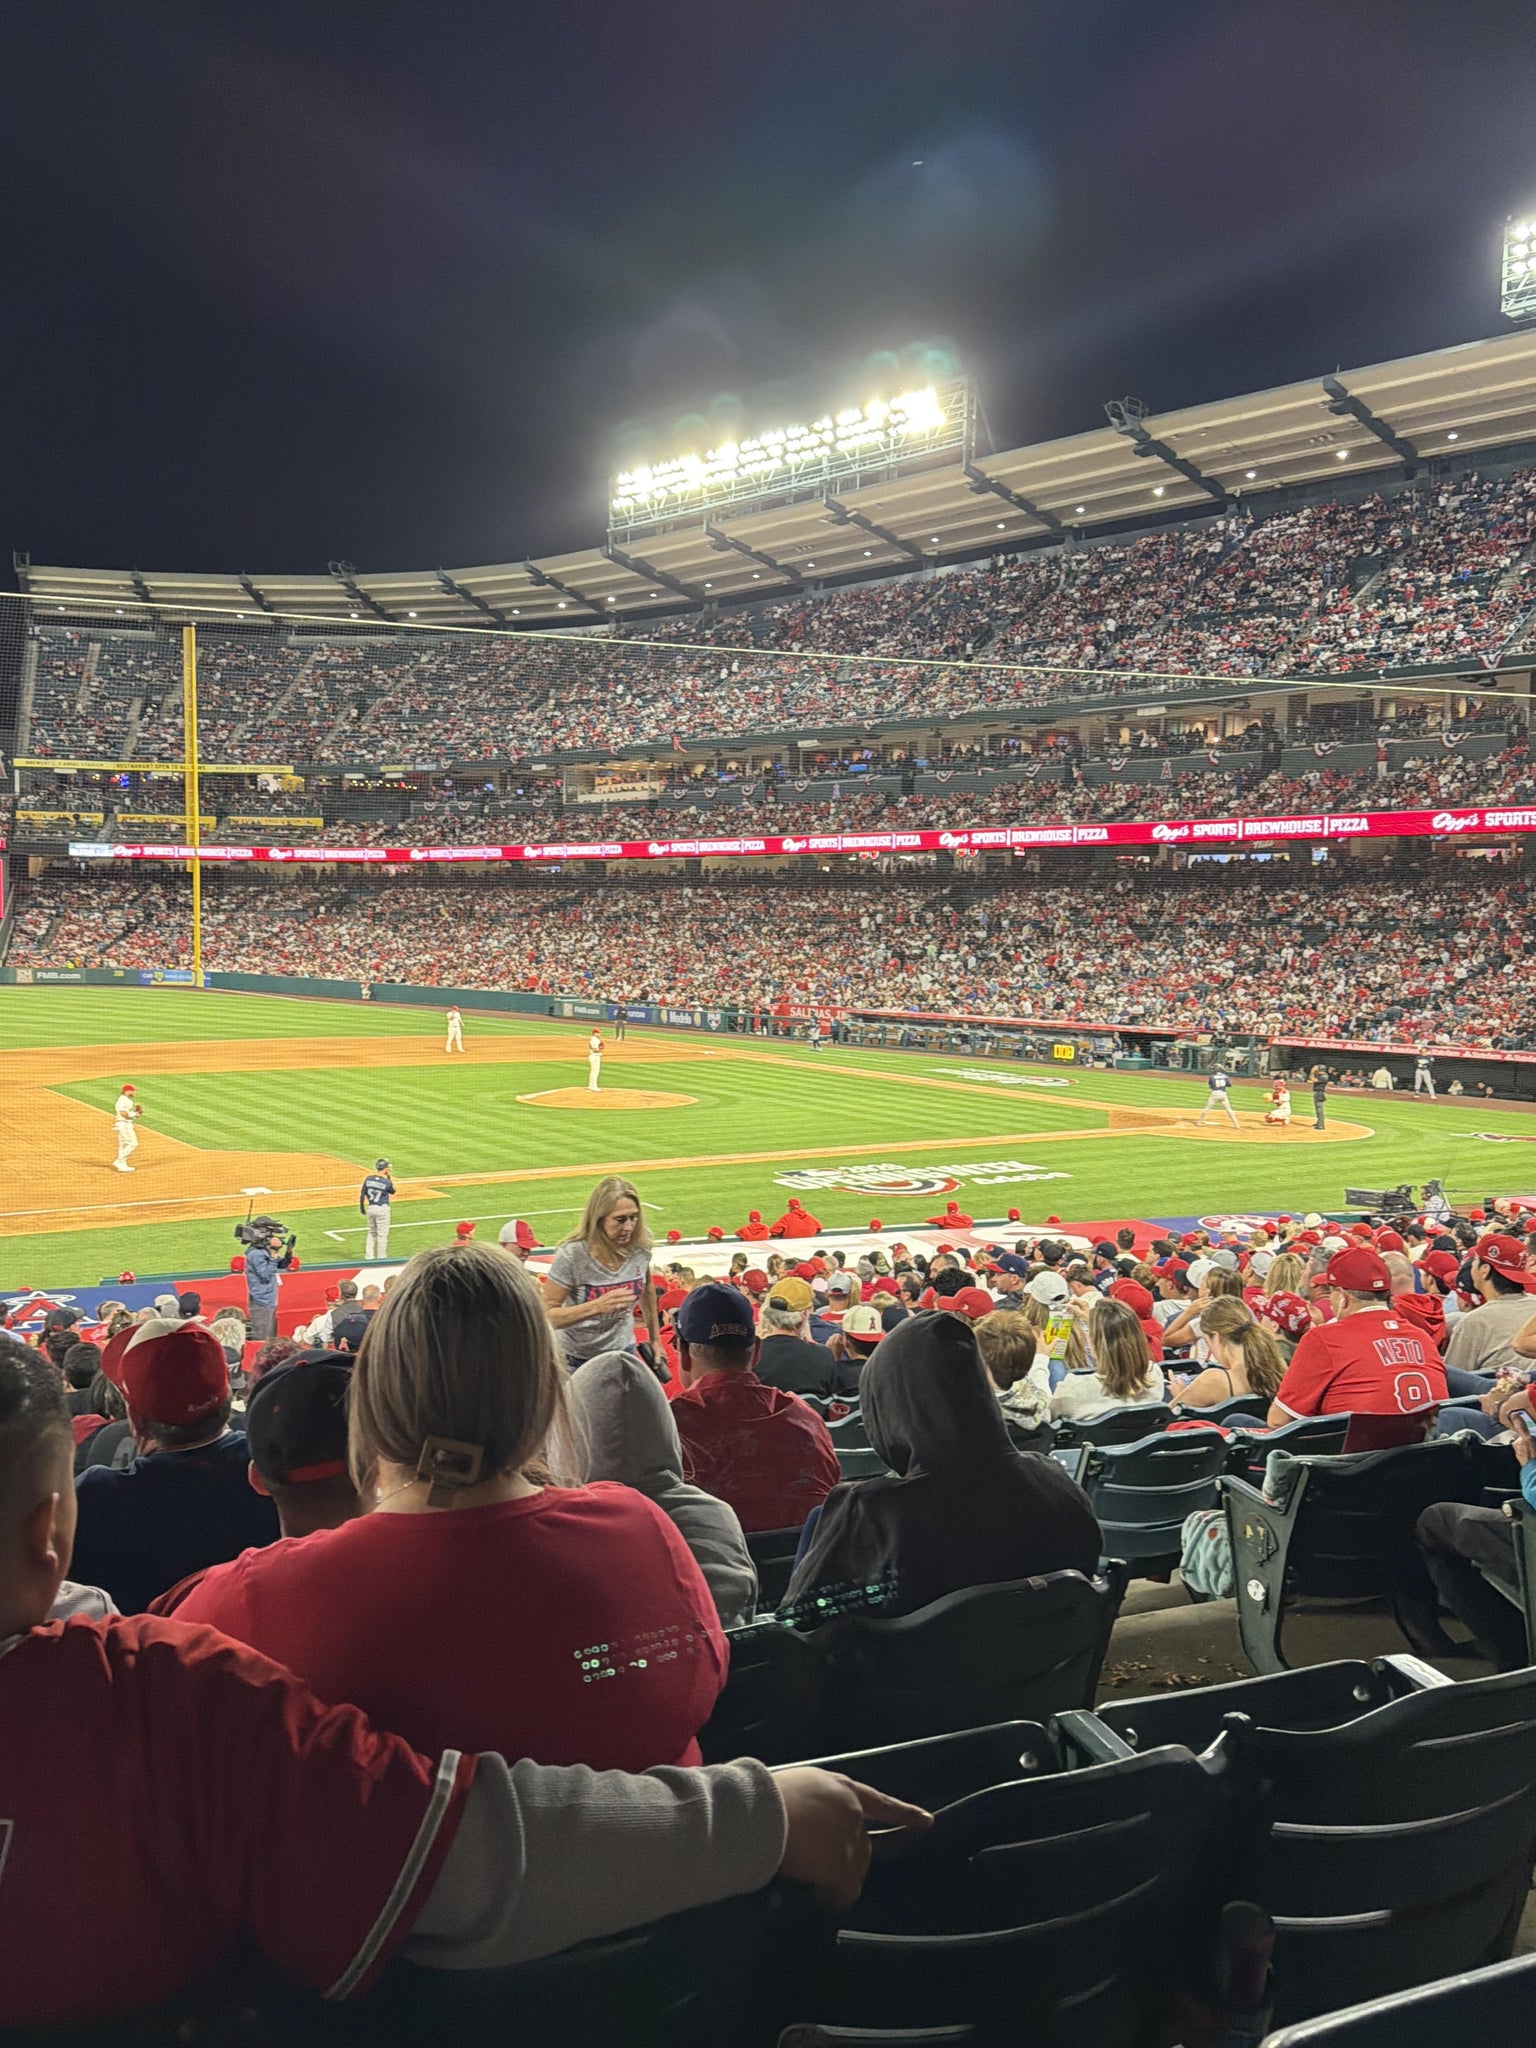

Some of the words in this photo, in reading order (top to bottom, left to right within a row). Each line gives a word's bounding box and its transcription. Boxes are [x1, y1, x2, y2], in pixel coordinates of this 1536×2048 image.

[1193, 823, 1238, 836] SPORTS
[1244, 819, 1323, 835] BREWHOUSE
[1330, 816, 1369, 832] PIZZA
[808, 838, 838, 849] SPORTS
[842, 835, 892, 848] BREWHOUSE
[896, 835, 921, 846] PIZZA
[971, 831, 1006, 844] SPORTS
[1011, 828, 1072, 843] BREWHOUSE
[1077, 827, 1109, 841] PIZZA
[367, 1188, 382, 1203] 57
[1372, 1338, 1426, 1366] NETO
